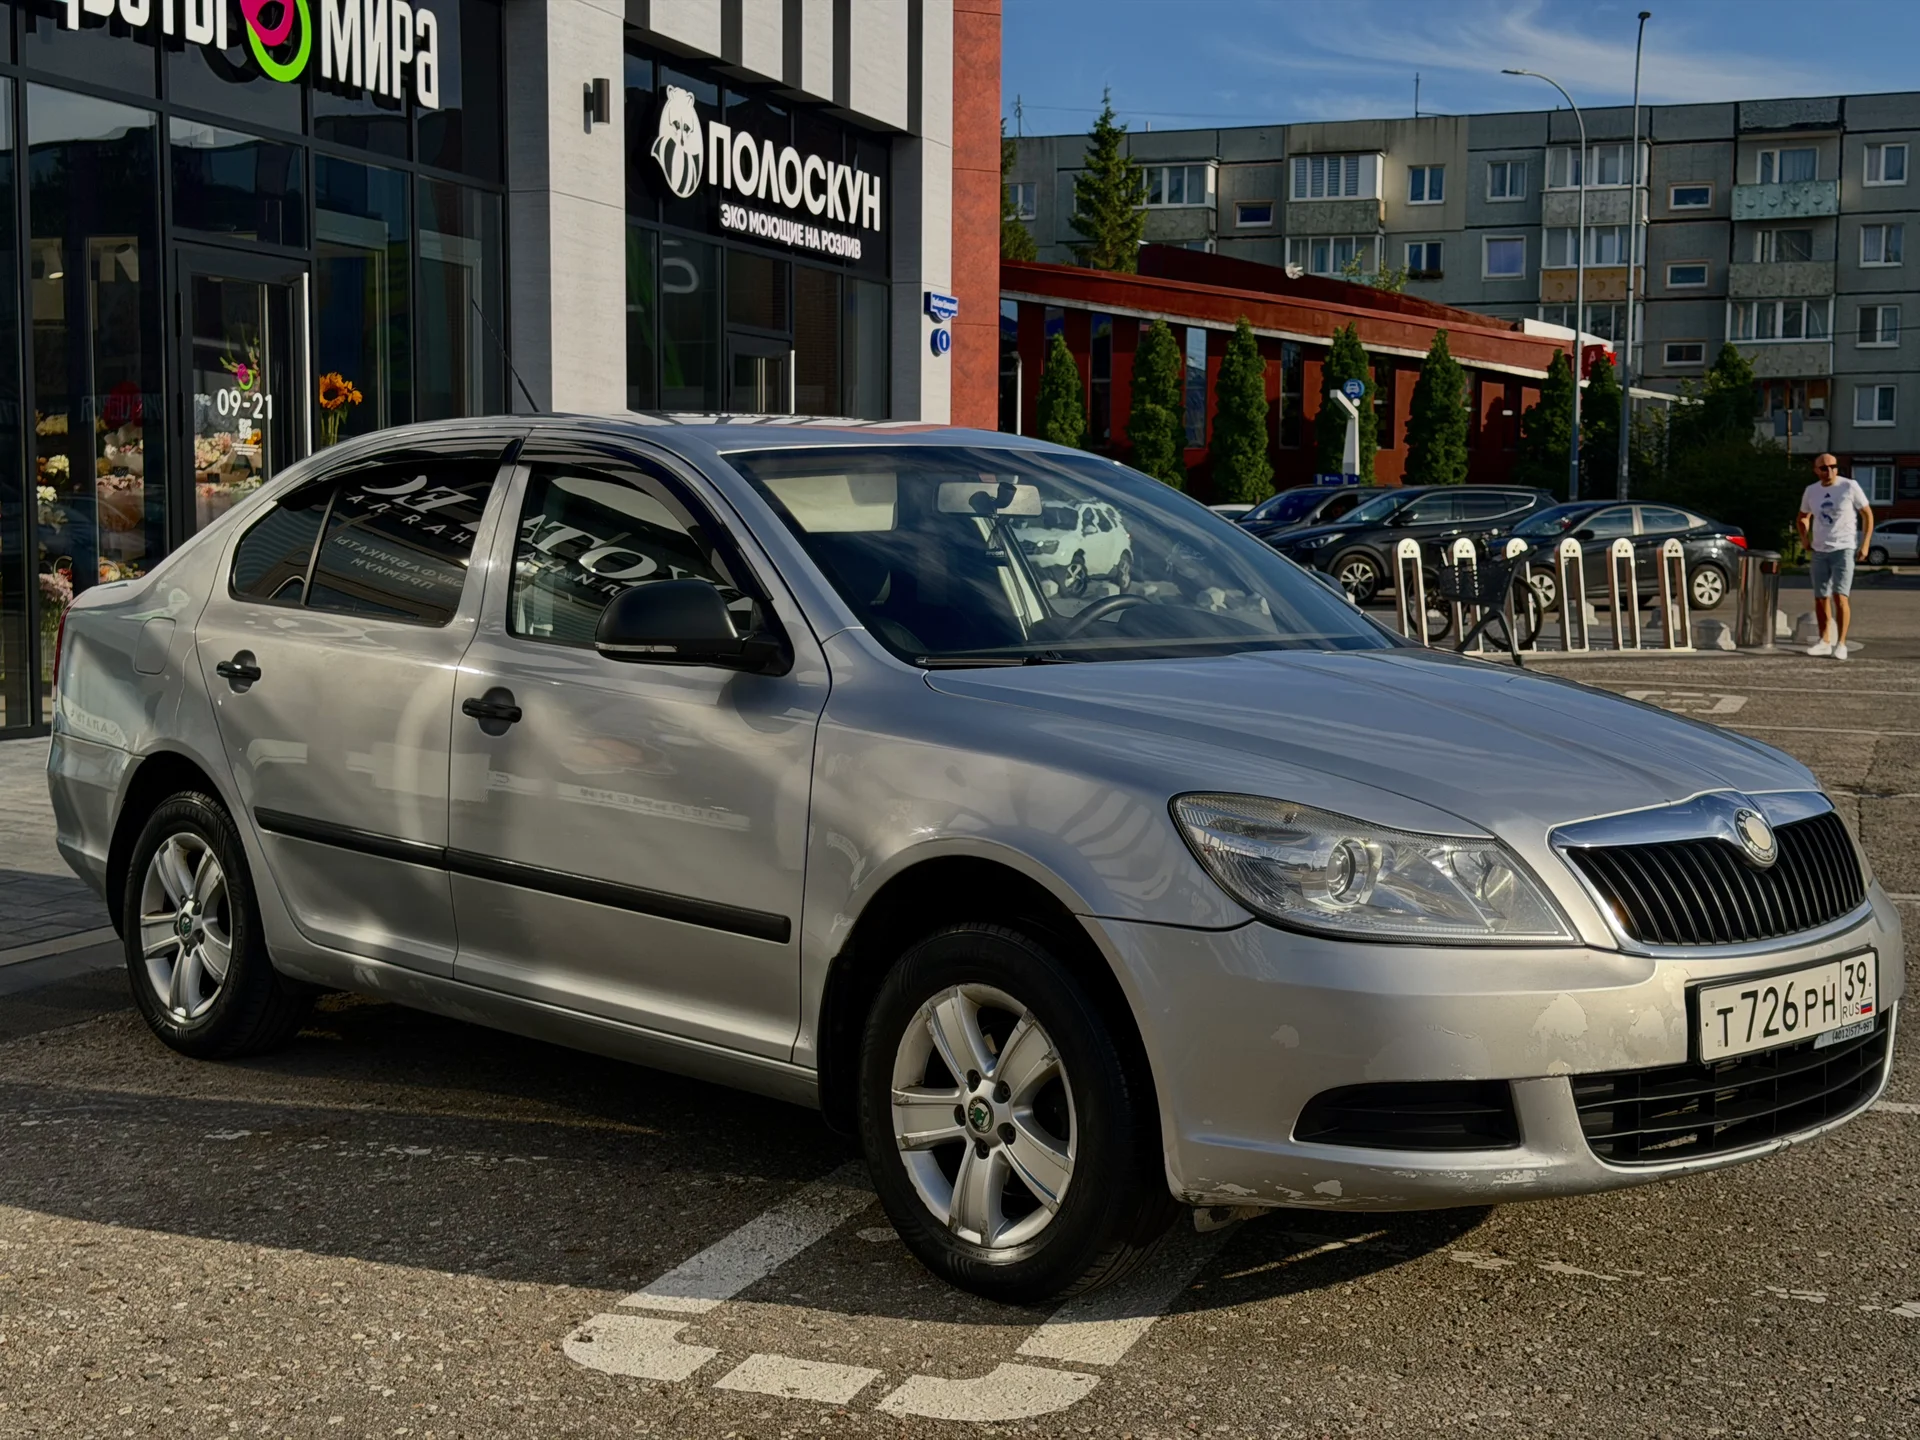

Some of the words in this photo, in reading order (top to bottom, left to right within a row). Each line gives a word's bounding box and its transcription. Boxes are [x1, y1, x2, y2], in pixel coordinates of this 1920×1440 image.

[709, 120, 881, 232] ПОЛОСКУН
[720, 203, 747, 231] ЭКО
[749, 210, 804, 246] МОЮЩИЕ
[805, 226, 821, 250] НА
[821, 231, 862, 260] РОЗЛИВ
[217, 388, 272, 420] 09-21
[1716, 981, 1836, 1047] Т726РН
[1844, 961, 1867, 1001] 39
[1842, 1001, 1861, 1019] RUS
